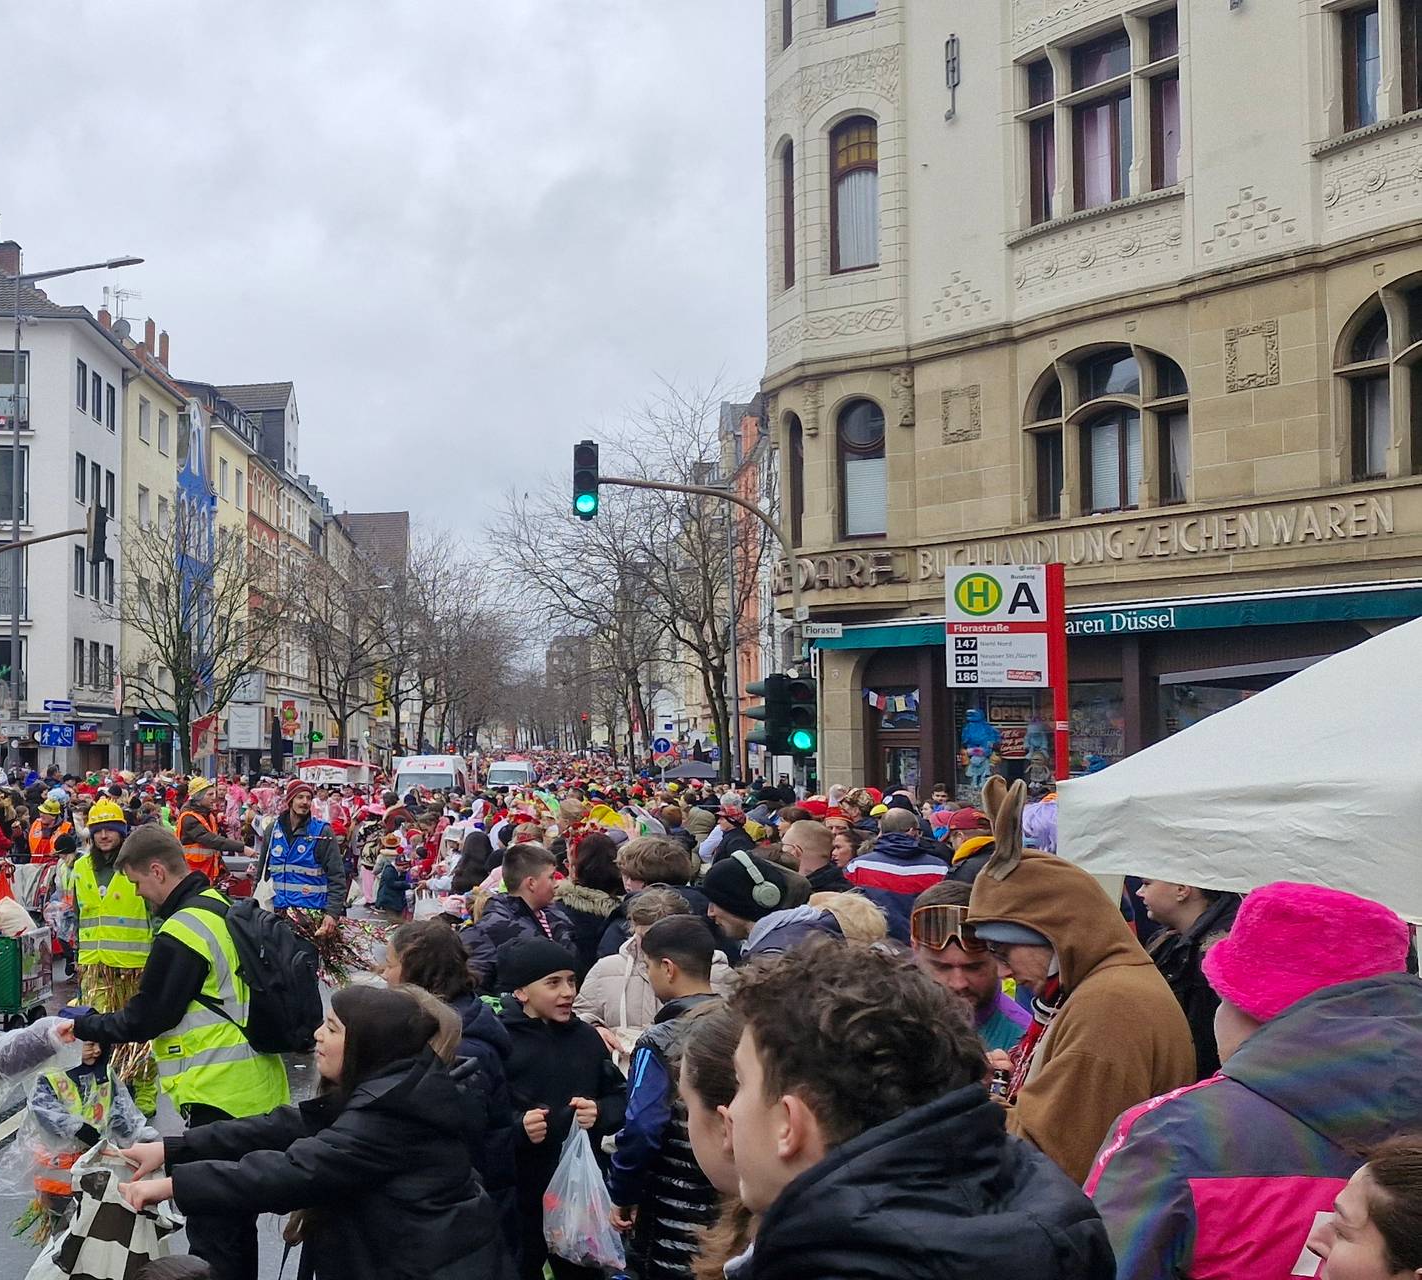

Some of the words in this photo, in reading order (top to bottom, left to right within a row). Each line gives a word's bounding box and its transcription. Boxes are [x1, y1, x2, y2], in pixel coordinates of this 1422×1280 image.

[967, 581, 990, 608] H
[1008, 582, 1040, 614] A
[1110, 607, 1176, 632] Düssel
[804, 626, 838, 635] Florastr.
[953, 623, 1010, 633] Florastraße
[955, 639, 977, 649] 147
[956, 655, 977, 665] 184
[956, 672, 978, 682] 186
